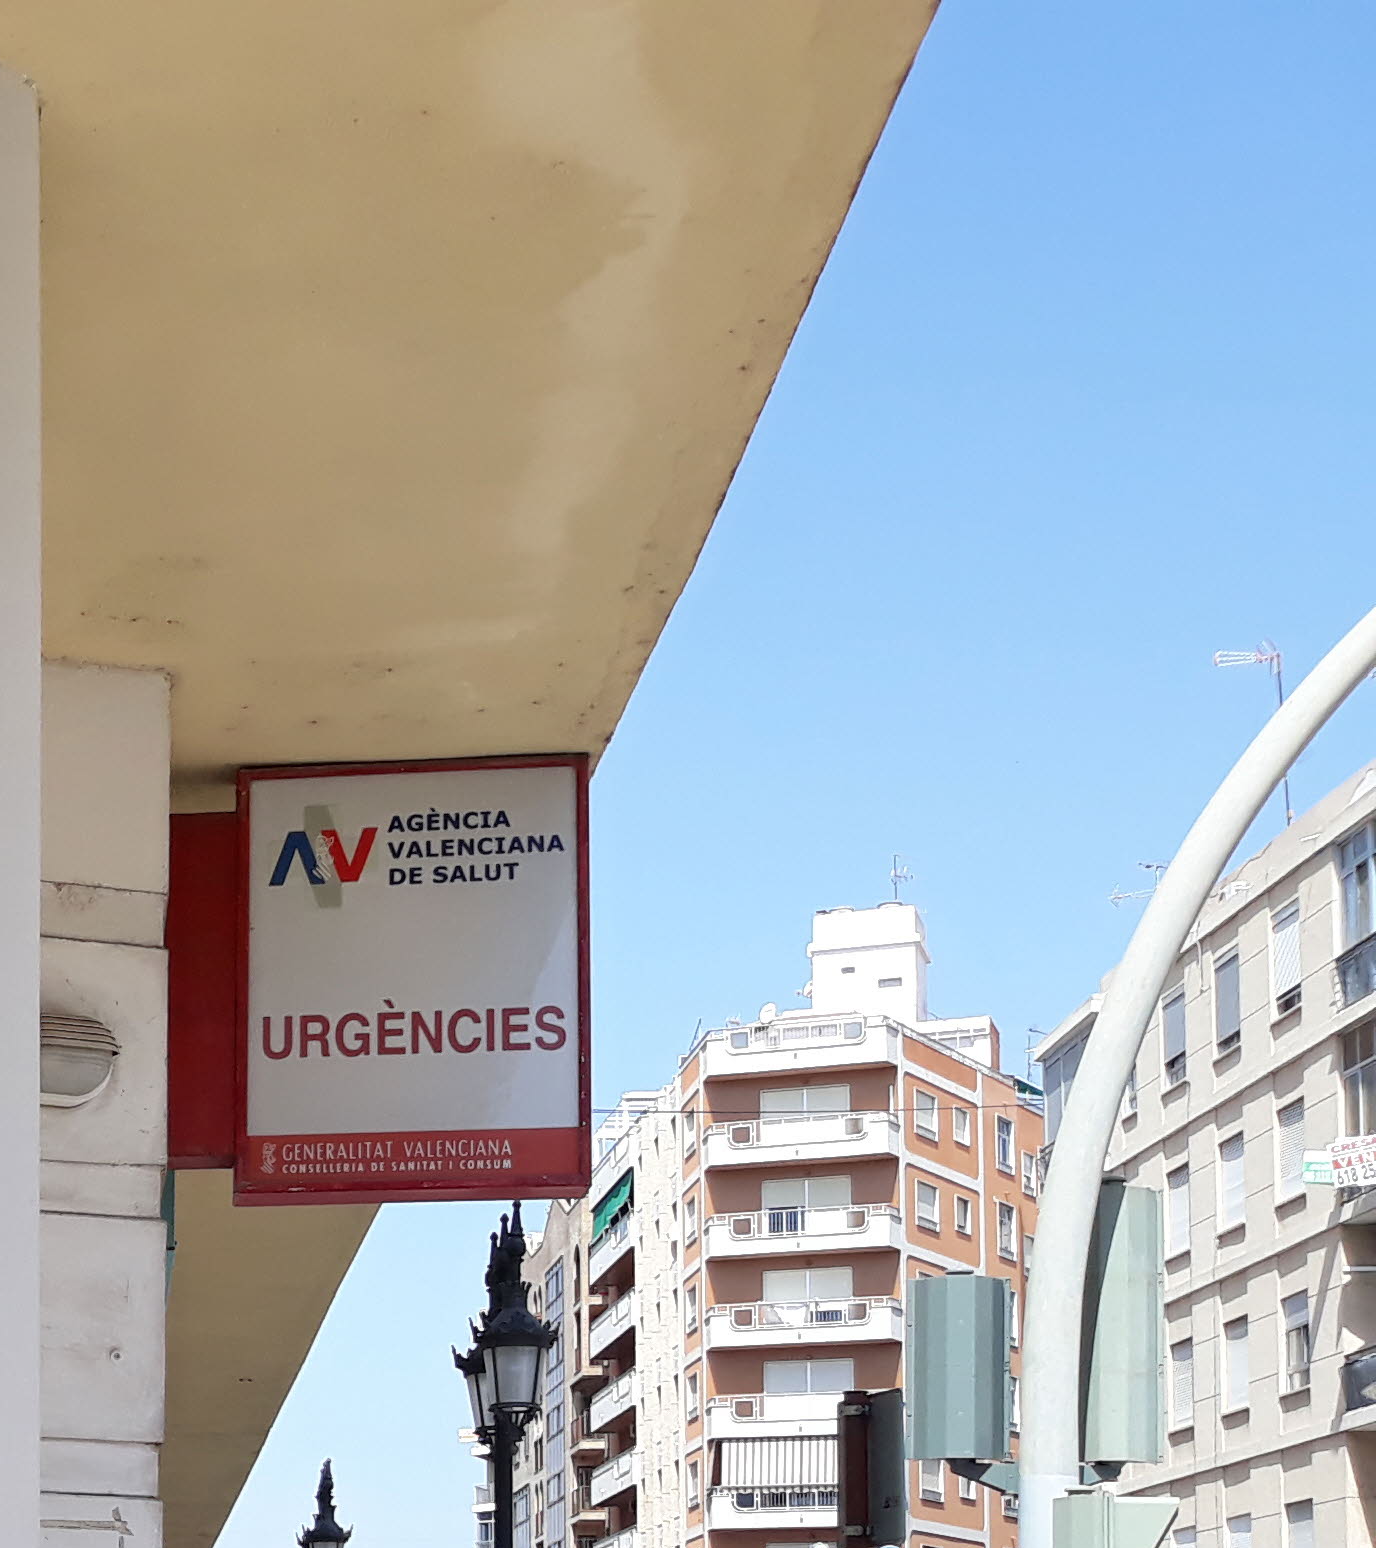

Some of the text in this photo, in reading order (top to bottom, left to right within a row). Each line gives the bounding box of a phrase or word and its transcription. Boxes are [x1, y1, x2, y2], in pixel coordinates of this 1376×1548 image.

[387, 808, 511, 833] AGÈNCIA
[387, 834, 565, 859] VALENCIANA
[388, 861, 520, 886] DE SALUT
[261, 998, 567, 1060] URGÈNCIES
[282, 1139, 513, 1161] GENERALITAT VALENCIANA
[282, 1161, 365, 1175] CONSELLERIA
[371, 1161, 385, 1172] DE
[391, 1160, 443, 1172] SANITAT
[459, 1158, 513, 1170] CONSUM
